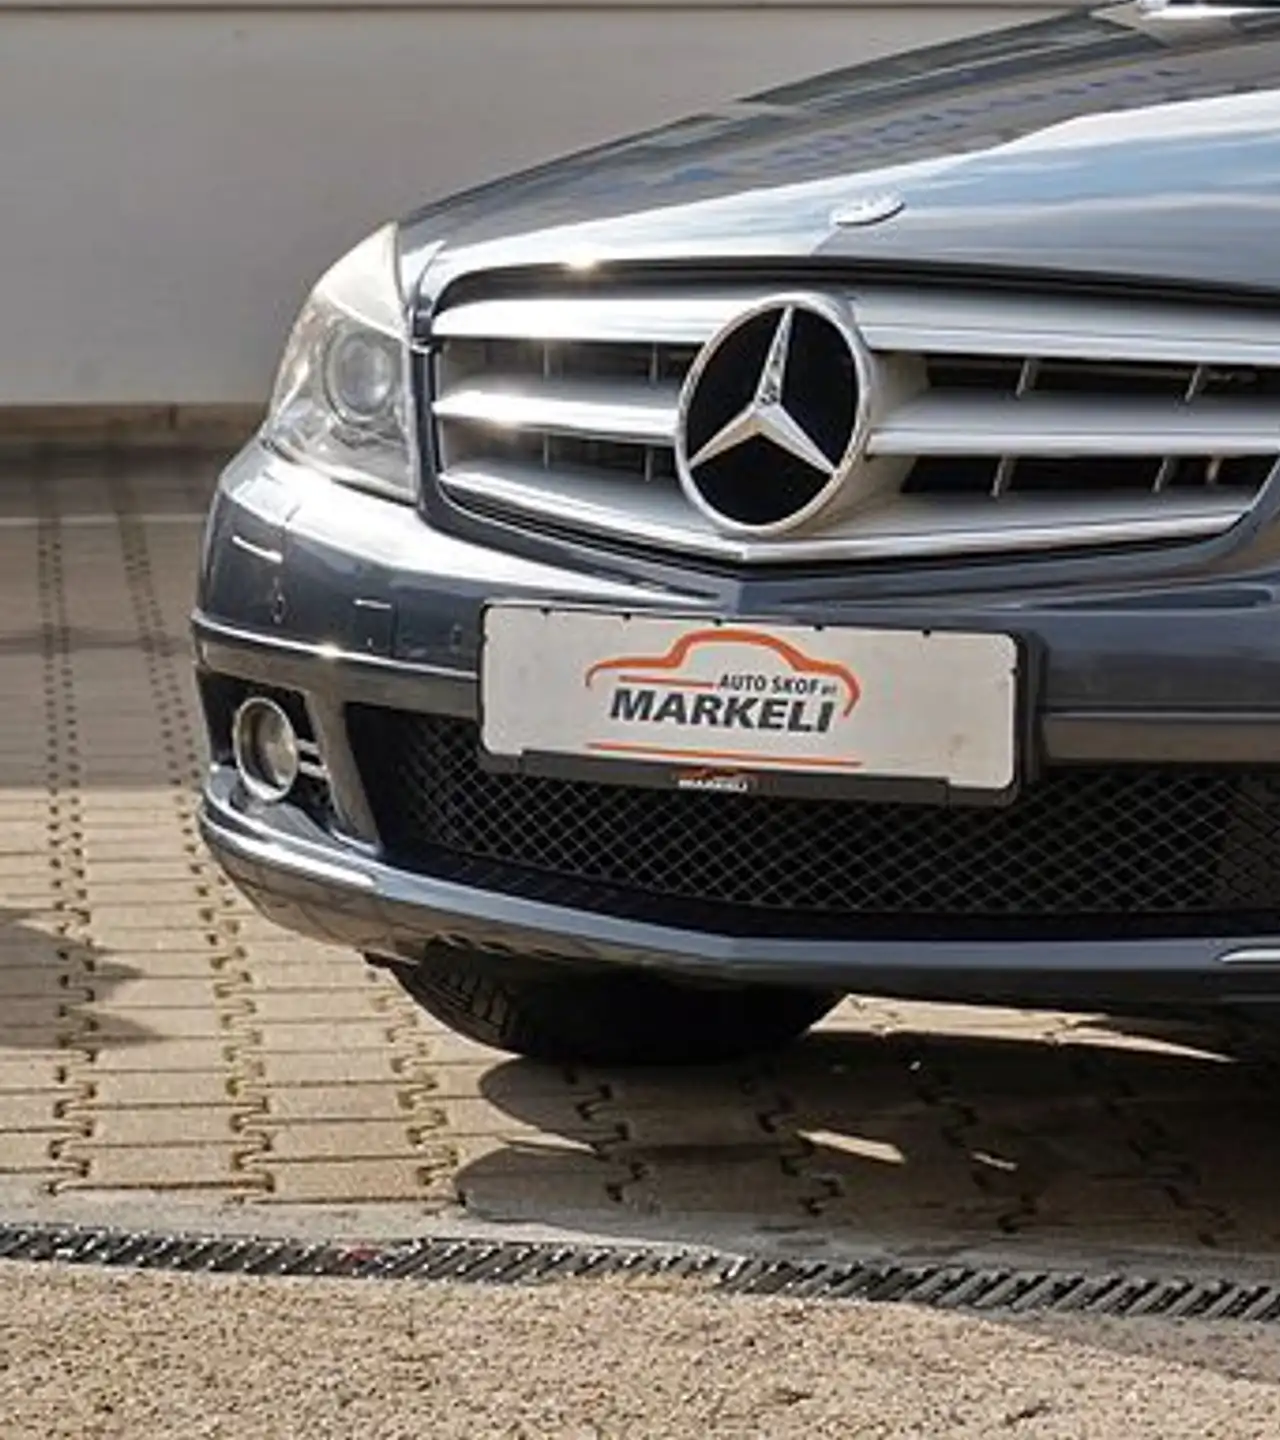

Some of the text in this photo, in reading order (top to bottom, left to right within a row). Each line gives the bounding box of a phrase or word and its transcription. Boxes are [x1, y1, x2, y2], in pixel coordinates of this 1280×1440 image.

[719, 673, 767, 692] AUTO
[770, 675, 819, 695] SKOF
[609, 688, 835, 734] MARKELI
